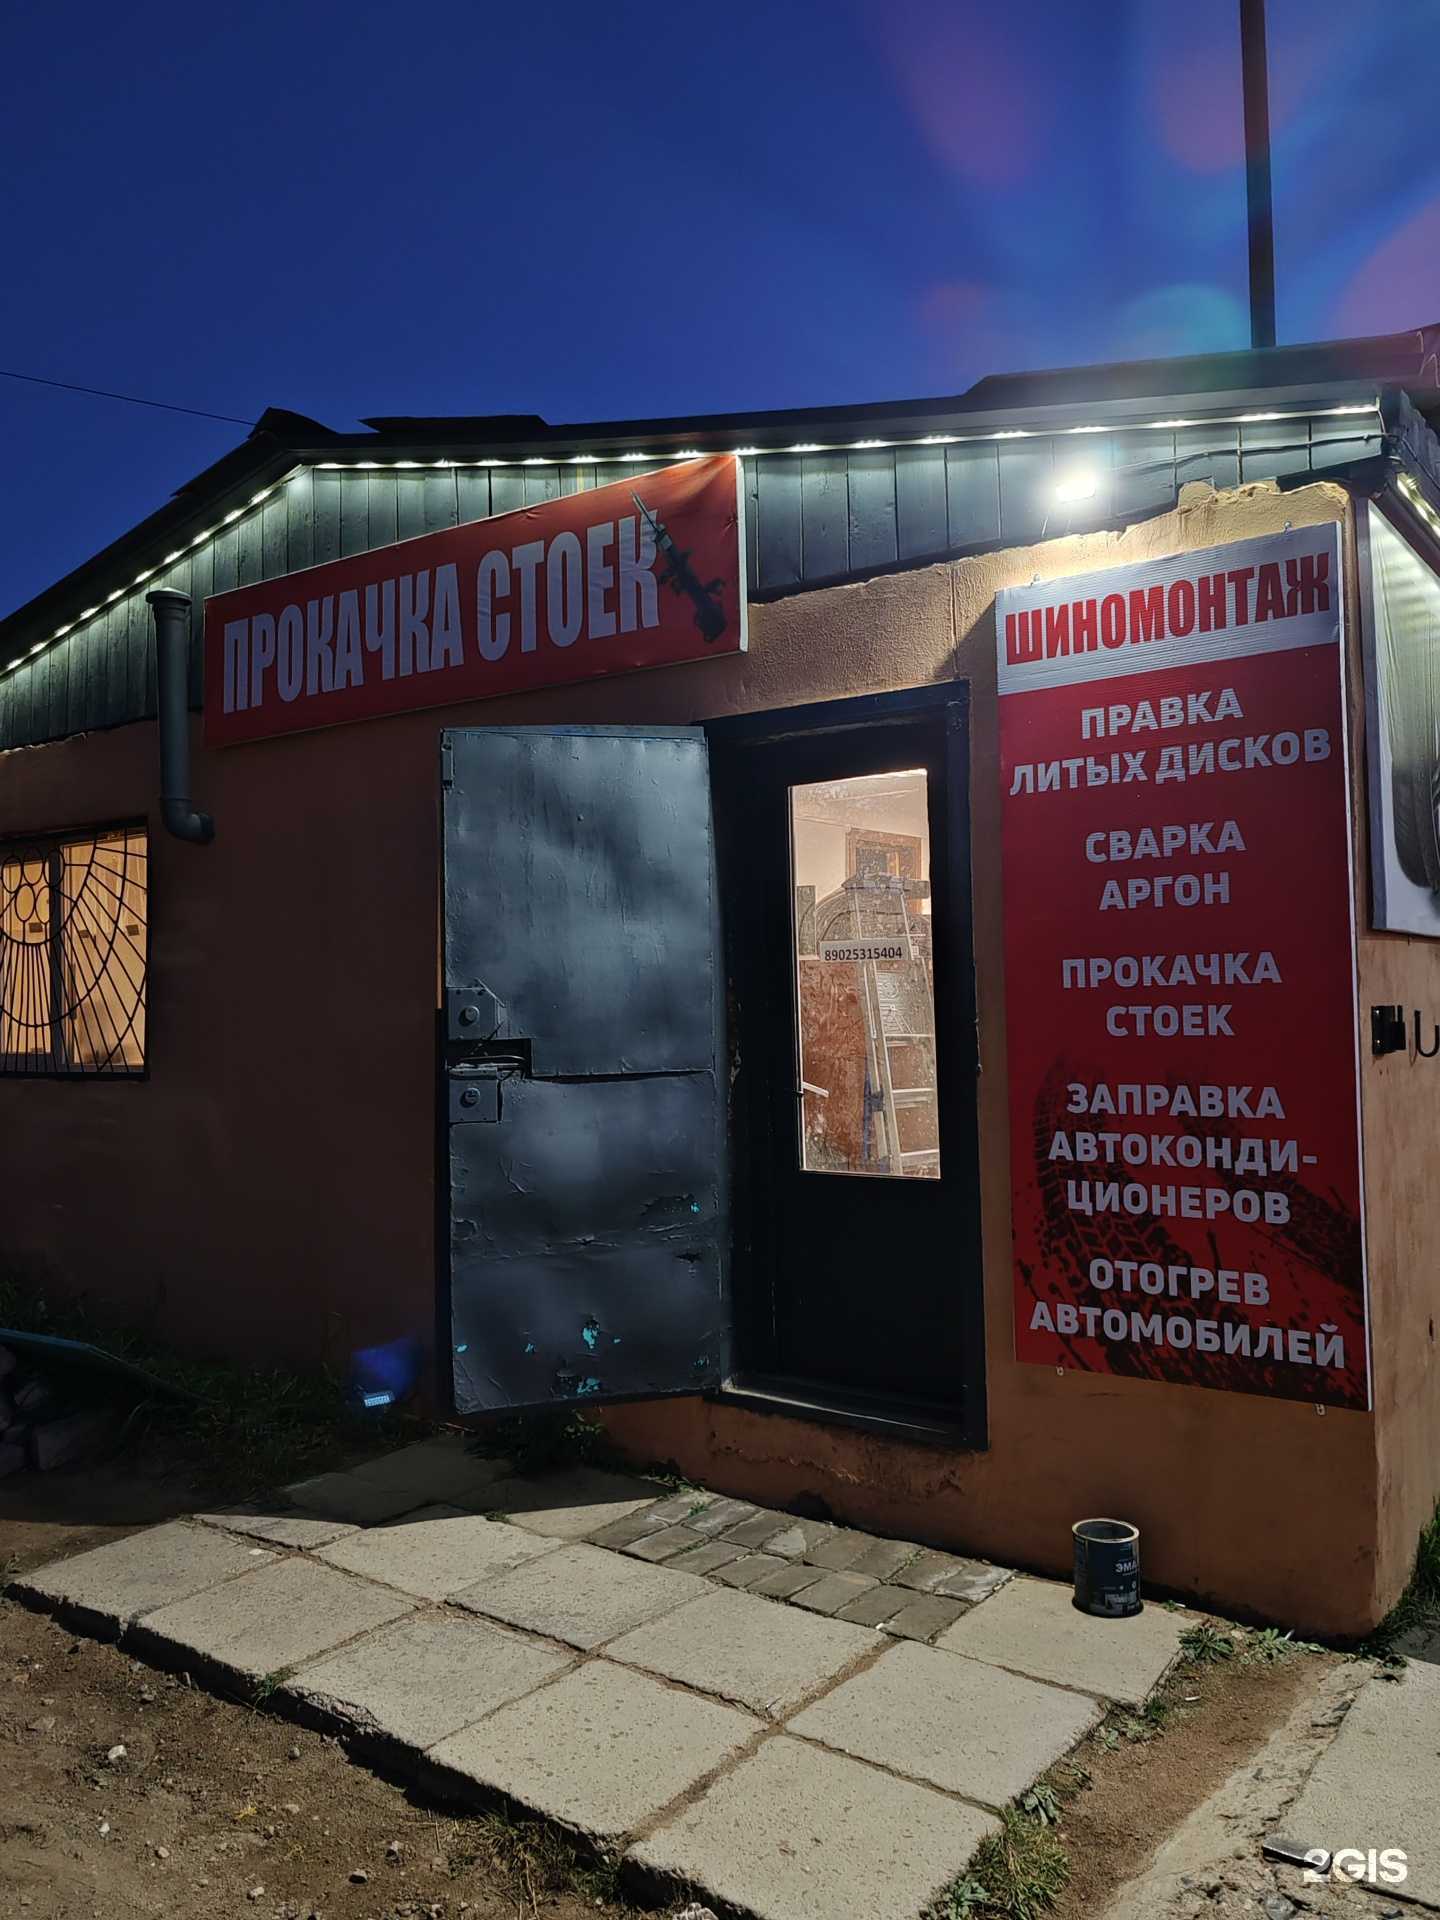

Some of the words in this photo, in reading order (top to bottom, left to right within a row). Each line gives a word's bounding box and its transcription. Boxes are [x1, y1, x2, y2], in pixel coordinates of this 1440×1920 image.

[223, 562, 465, 714] ПРОКАЧКА
[477, 509, 661, 662] СТОЕК
[1005, 551, 1330, 665] ШИНОМОНТАЖ
[1081, 688, 1244, 739] ПРАВКА
[1009, 750, 1148, 796] ЛИТЫХ
[1155, 728, 1331, 784] ДИСКОВ
[1085, 820, 1247, 863] СВАРКА
[1099, 871, 1231, 911] АРГОН
[824, 947, 902, 961] 89025315404
[1061, 951, 1283, 989] ПРОКАЧКА
[1105, 1004, 1236, 1037] СТОЕК
[1065, 1082, 1286, 1120] ЗАПРАВКА
[1048, 1131, 1318, 1177] АВТОКОНДИ-
[1066, 1179, 1292, 1225] ЦИОНЕРОВ
[1089, 1258, 1270, 1306] ОТОГРЕВ
[1029, 1301, 1345, 1369] АВТОМОБИЛЕЙ
